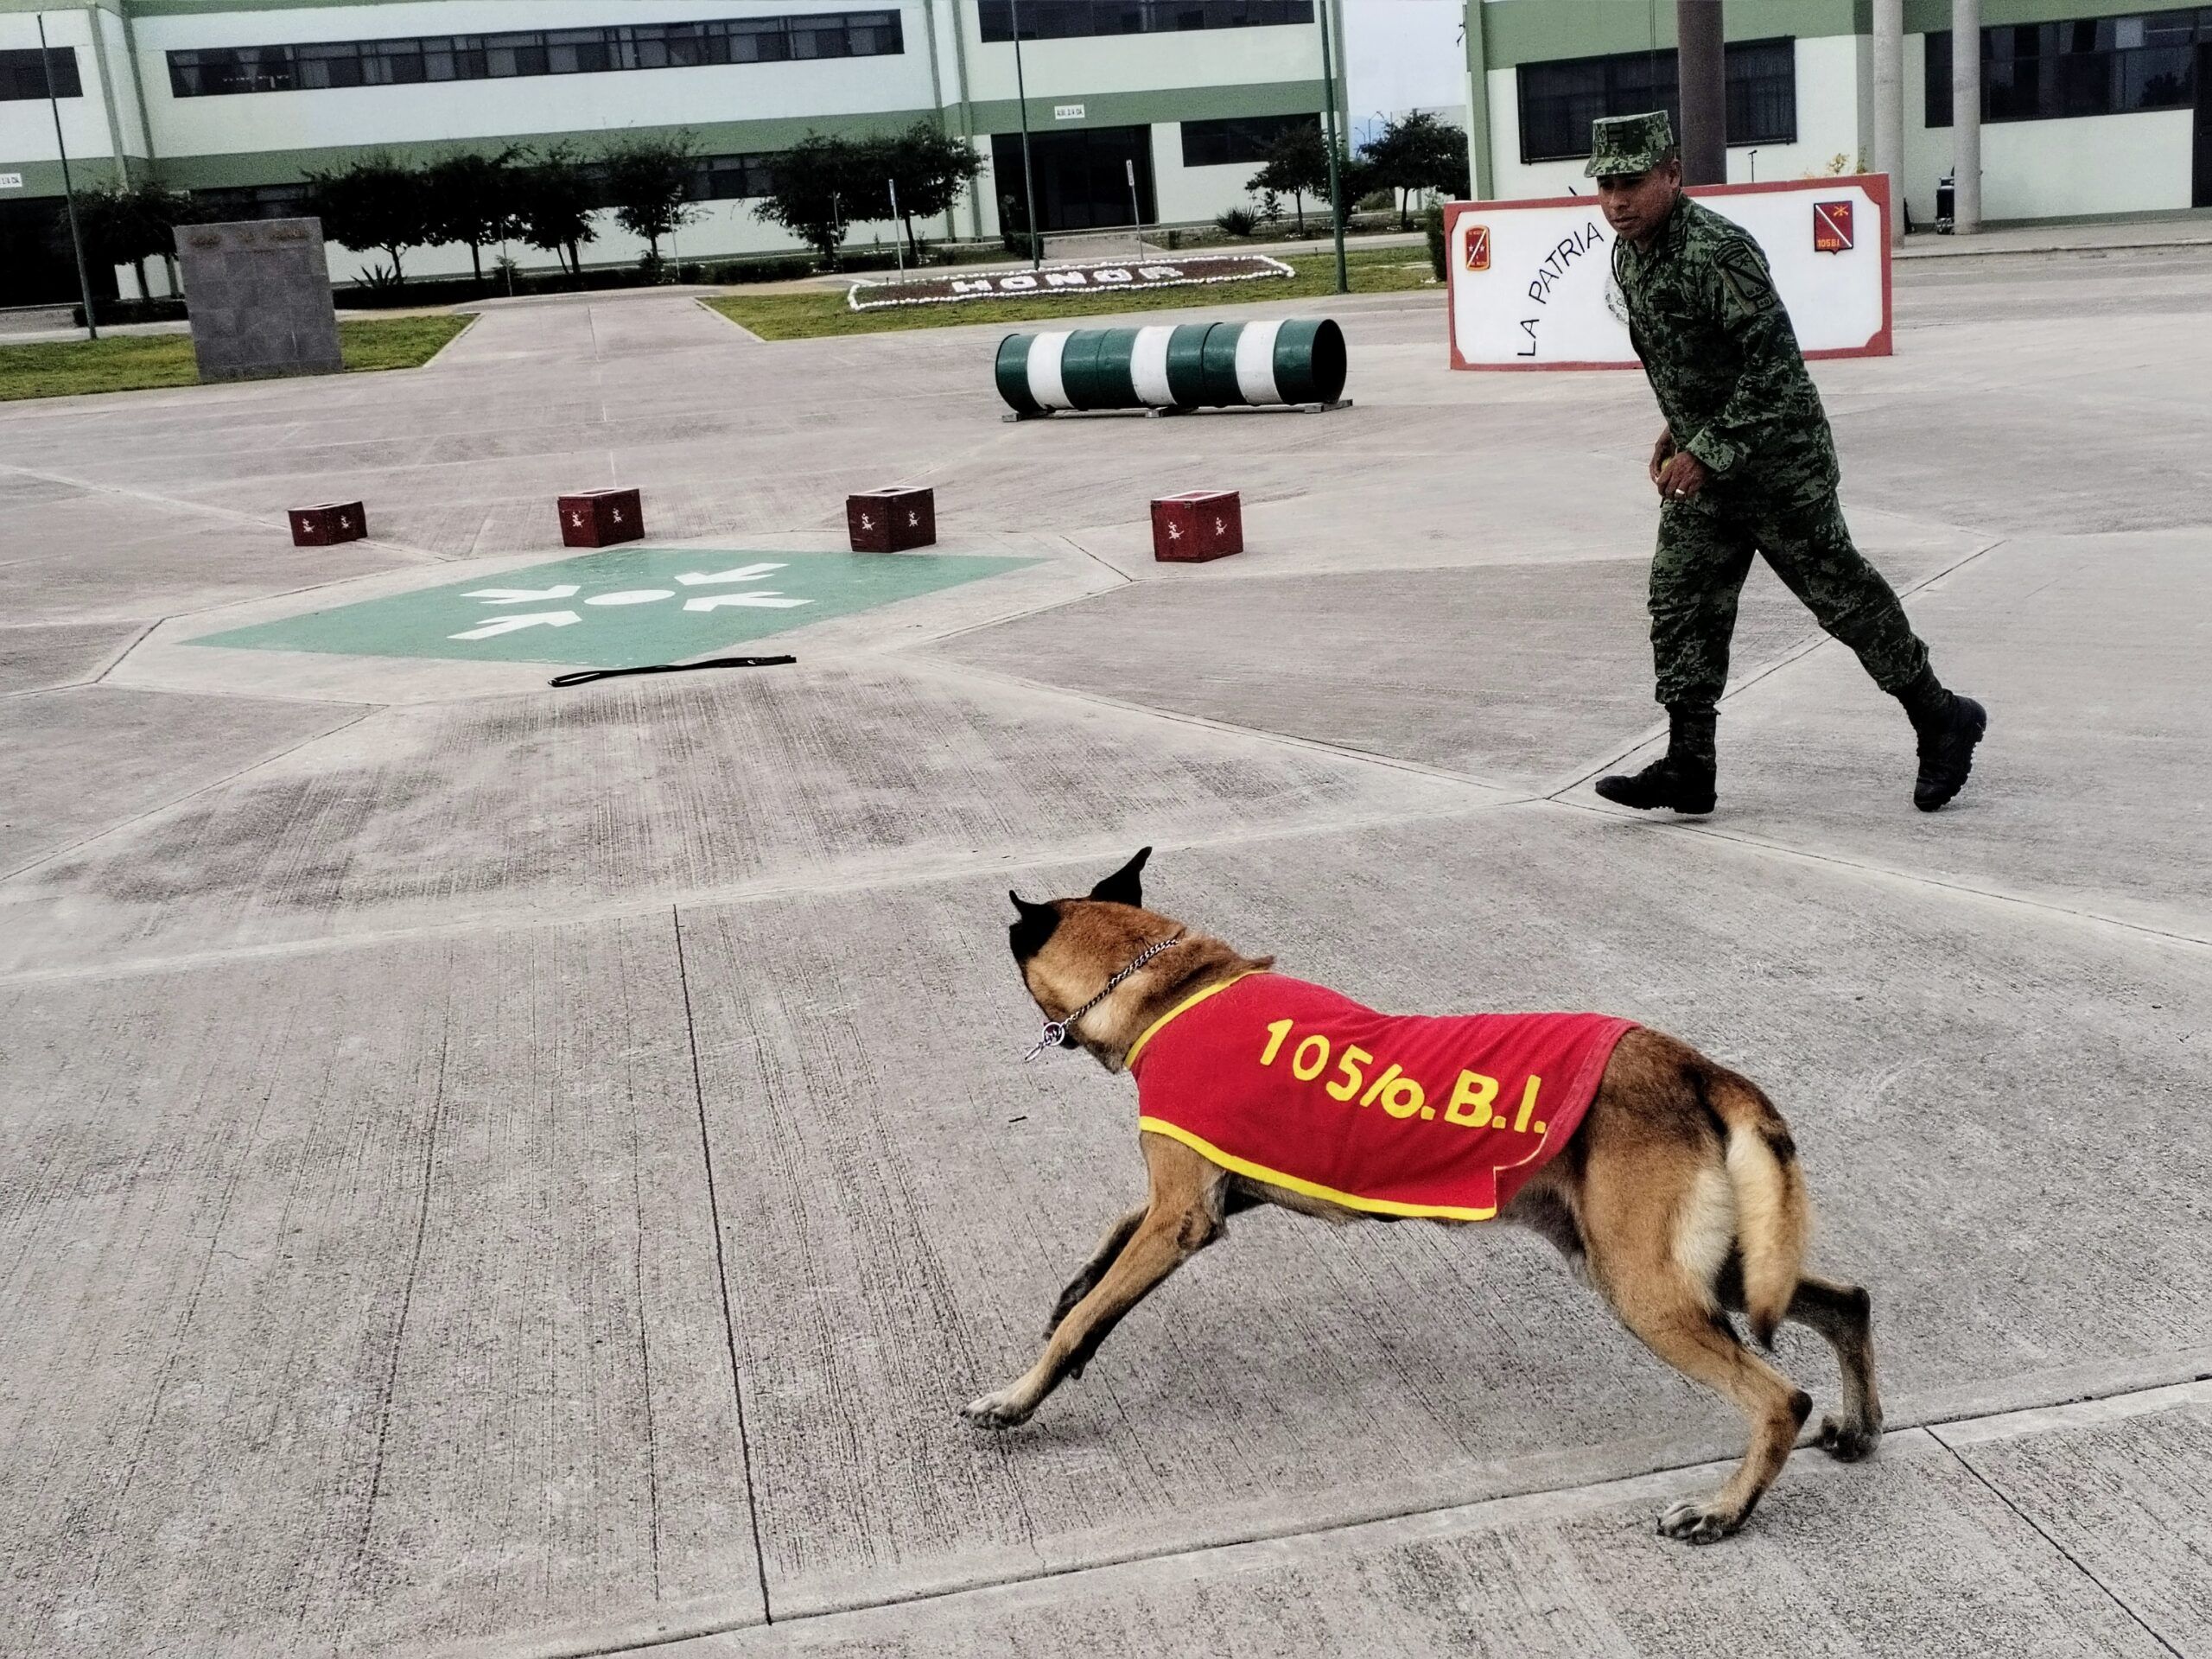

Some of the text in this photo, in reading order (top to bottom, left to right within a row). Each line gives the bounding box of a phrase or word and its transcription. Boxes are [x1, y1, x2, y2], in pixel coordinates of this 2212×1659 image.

[951, 266, 1184, 293] HONOR
[1517, 222, 1604, 357] LA PATRIA
